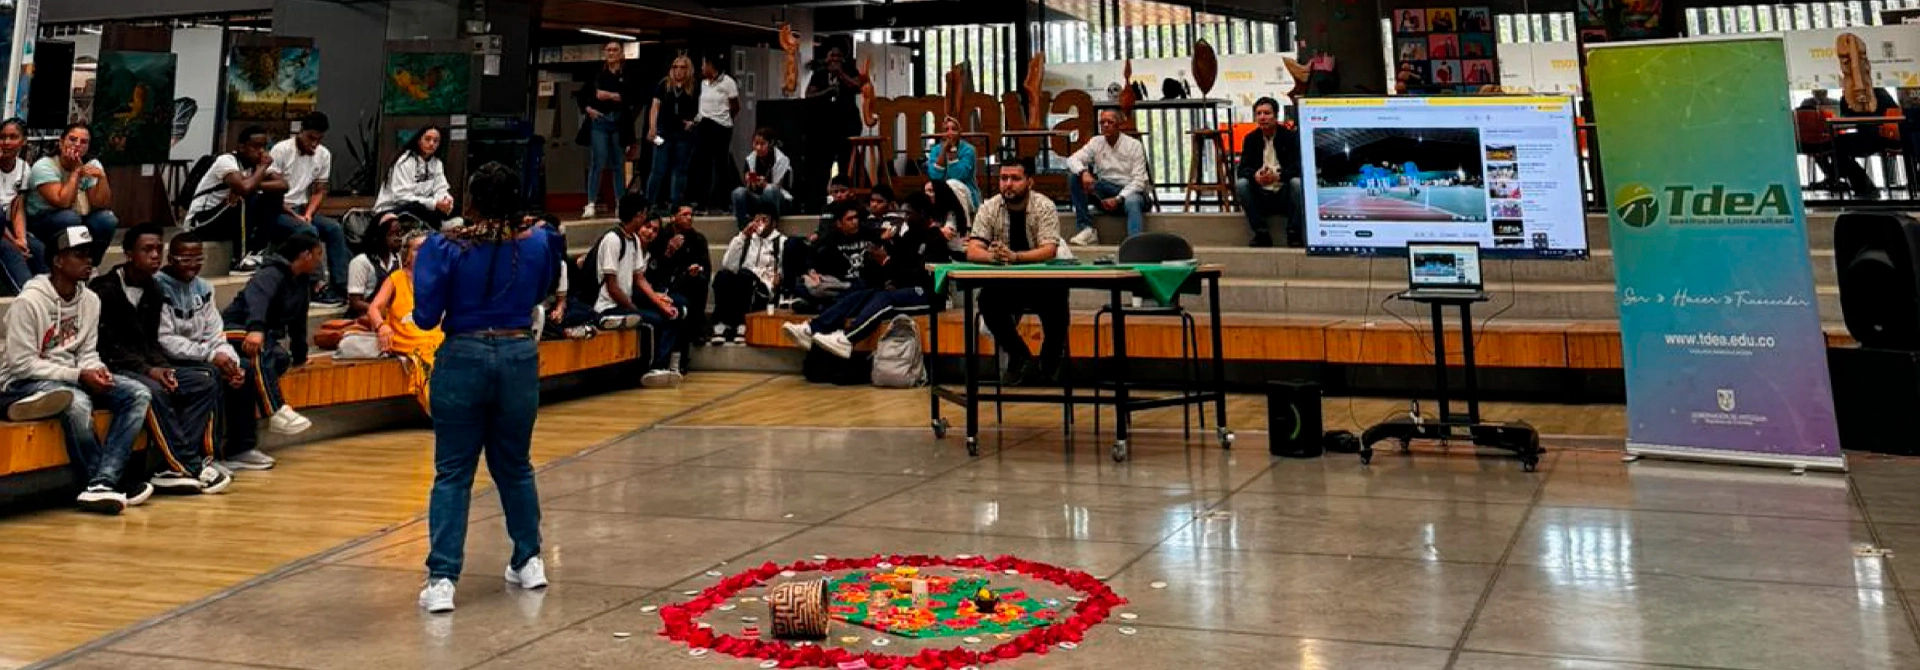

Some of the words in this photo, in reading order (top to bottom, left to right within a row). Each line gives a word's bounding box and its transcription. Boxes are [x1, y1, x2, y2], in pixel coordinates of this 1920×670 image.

[1664, 184, 1792, 216] TdeA
[1622, 286, 1651, 306] Ser
[1673, 288, 1722, 307] Hacer
[1664, 332, 1776, 348] www.tdea.edu.co
